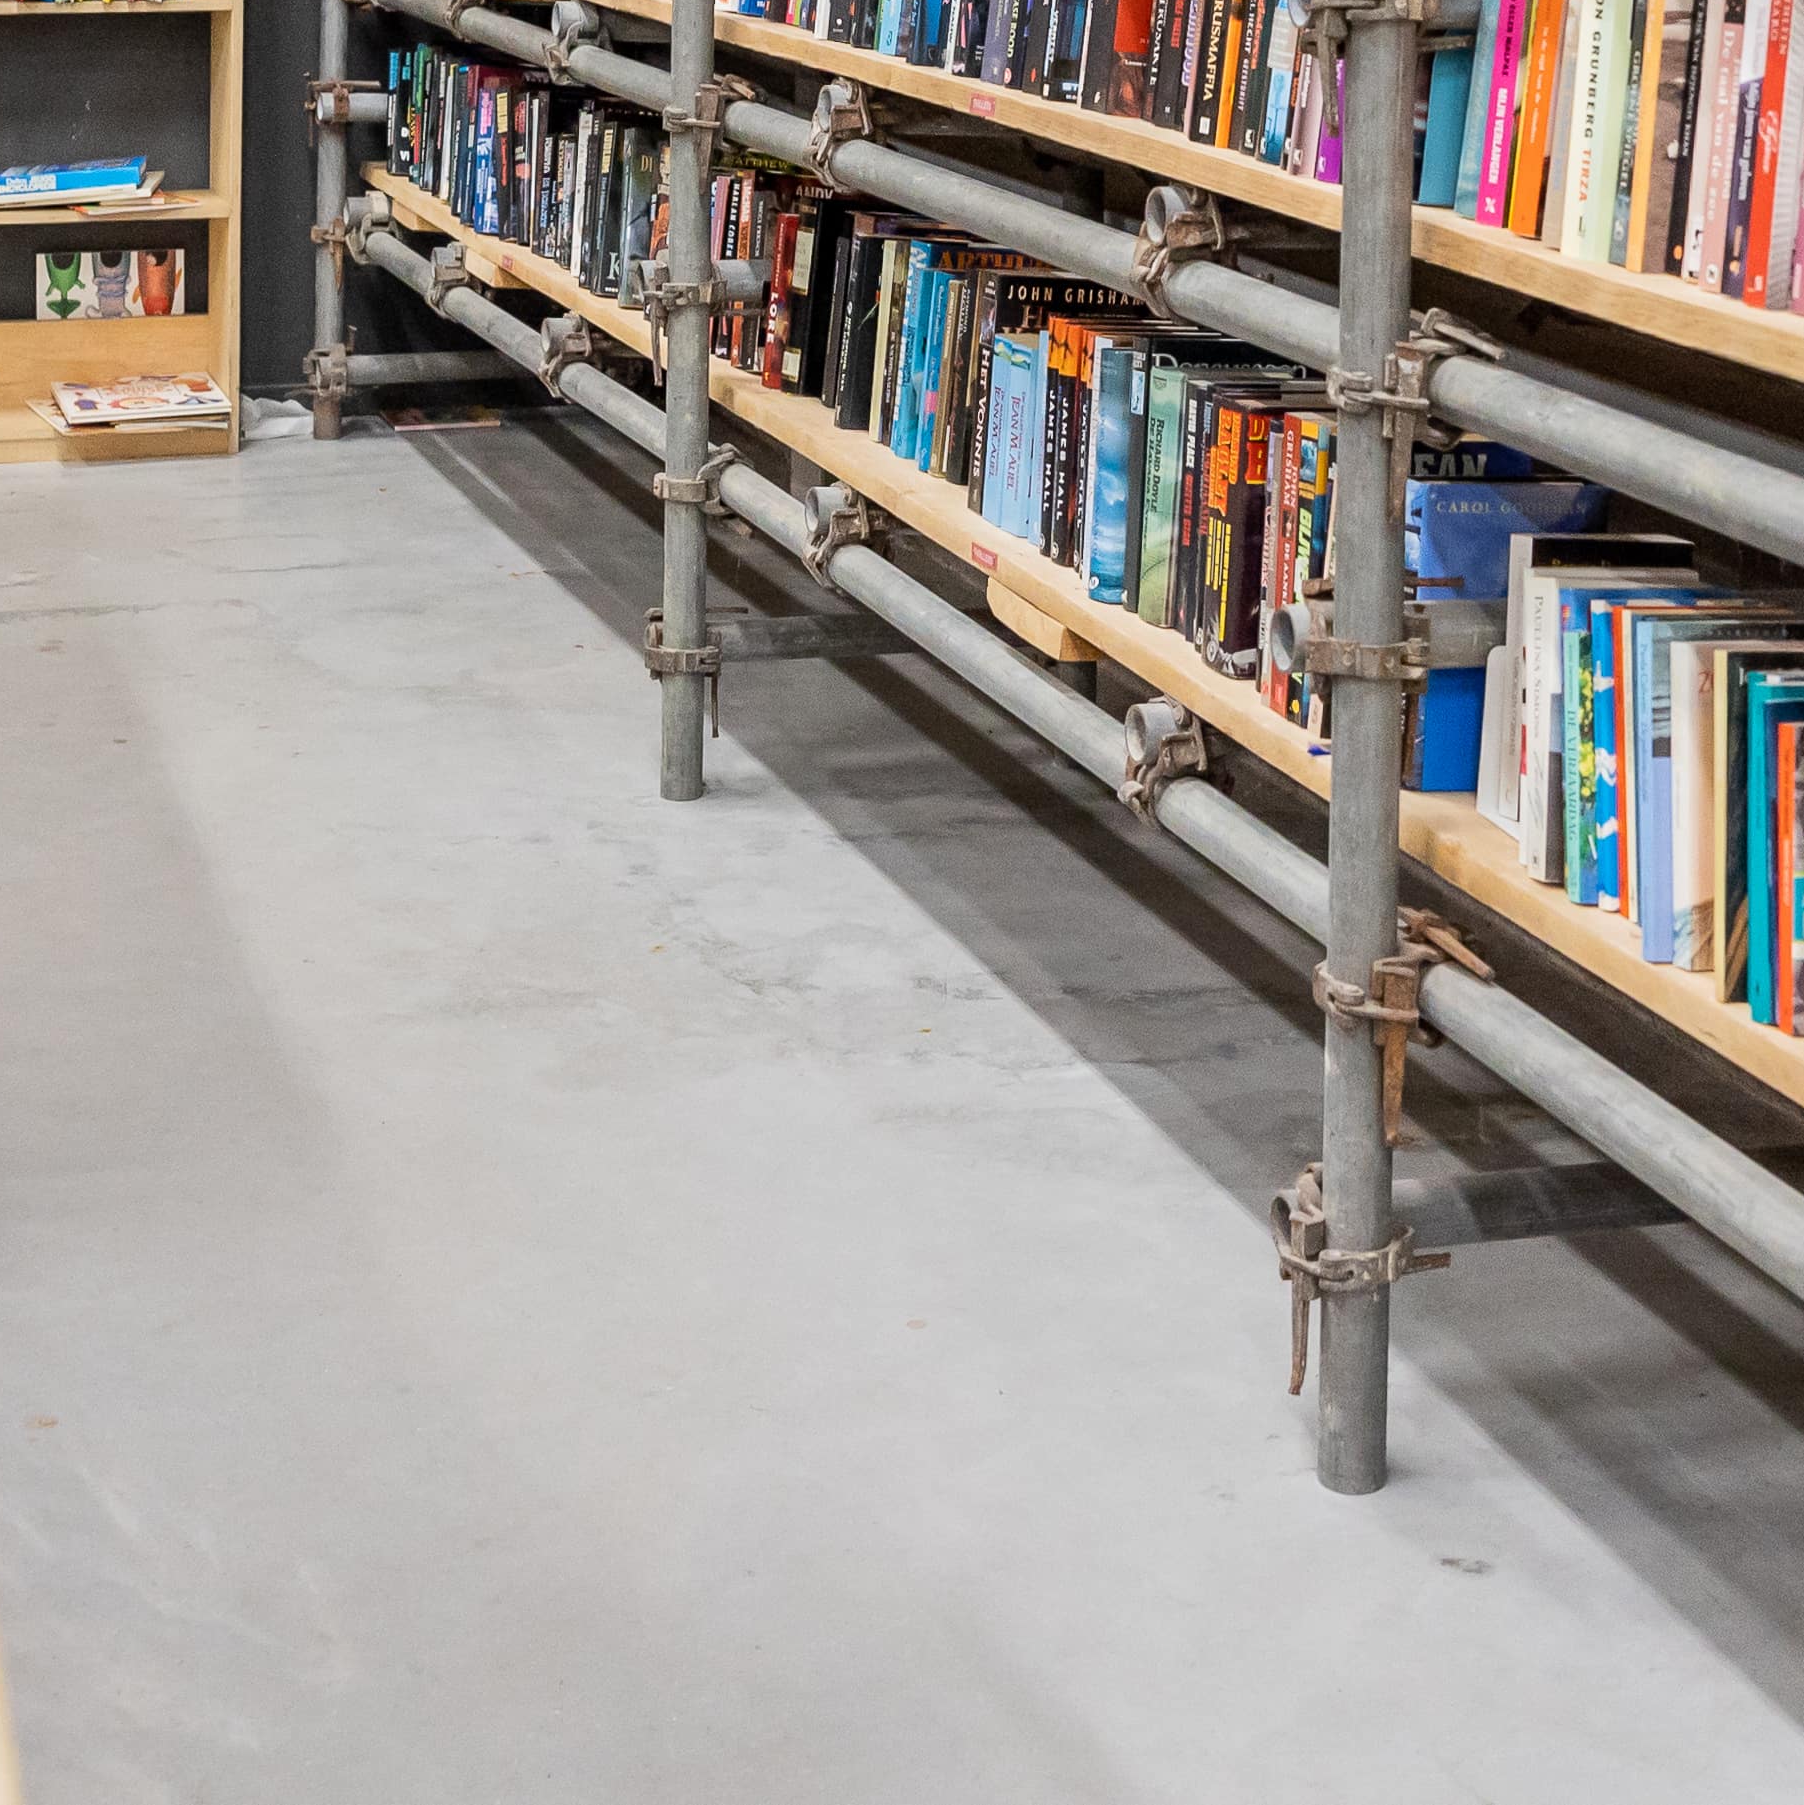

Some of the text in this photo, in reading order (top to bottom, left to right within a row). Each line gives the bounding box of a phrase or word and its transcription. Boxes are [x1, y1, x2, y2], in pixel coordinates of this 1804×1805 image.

[1005, 21, 1018, 58] ROOD
[1583, 31, 1603, 141] GRUNBERG
[1708, 30, 1735, 221] De taal van de zee
[1577, 149, 1593, 203] TIRZA
[725, 182, 741, 259] HARLAN COBEN
[766, 291, 779, 344] LORE
[1007, 283, 1055, 301] JOHN
[971, 348, 990, 478] HET VONNIS
[1007, 395, 1021, 429] JEAN
[1006, 456, 1017, 491] AUEL
[1041, 389, 1057, 514] JAMES HALL
[1054, 396, 1071, 522] JAMES HALL
[1150, 418, 1165, 514] RICHARD DOYLE
[1215, 407, 1231, 517] BAGLEY
[1283, 430, 1295, 506] GRISHAM
[1436, 501, 1491, 513] CAROL
[1566, 709, 1580, 842] DE VERJAARDAG
